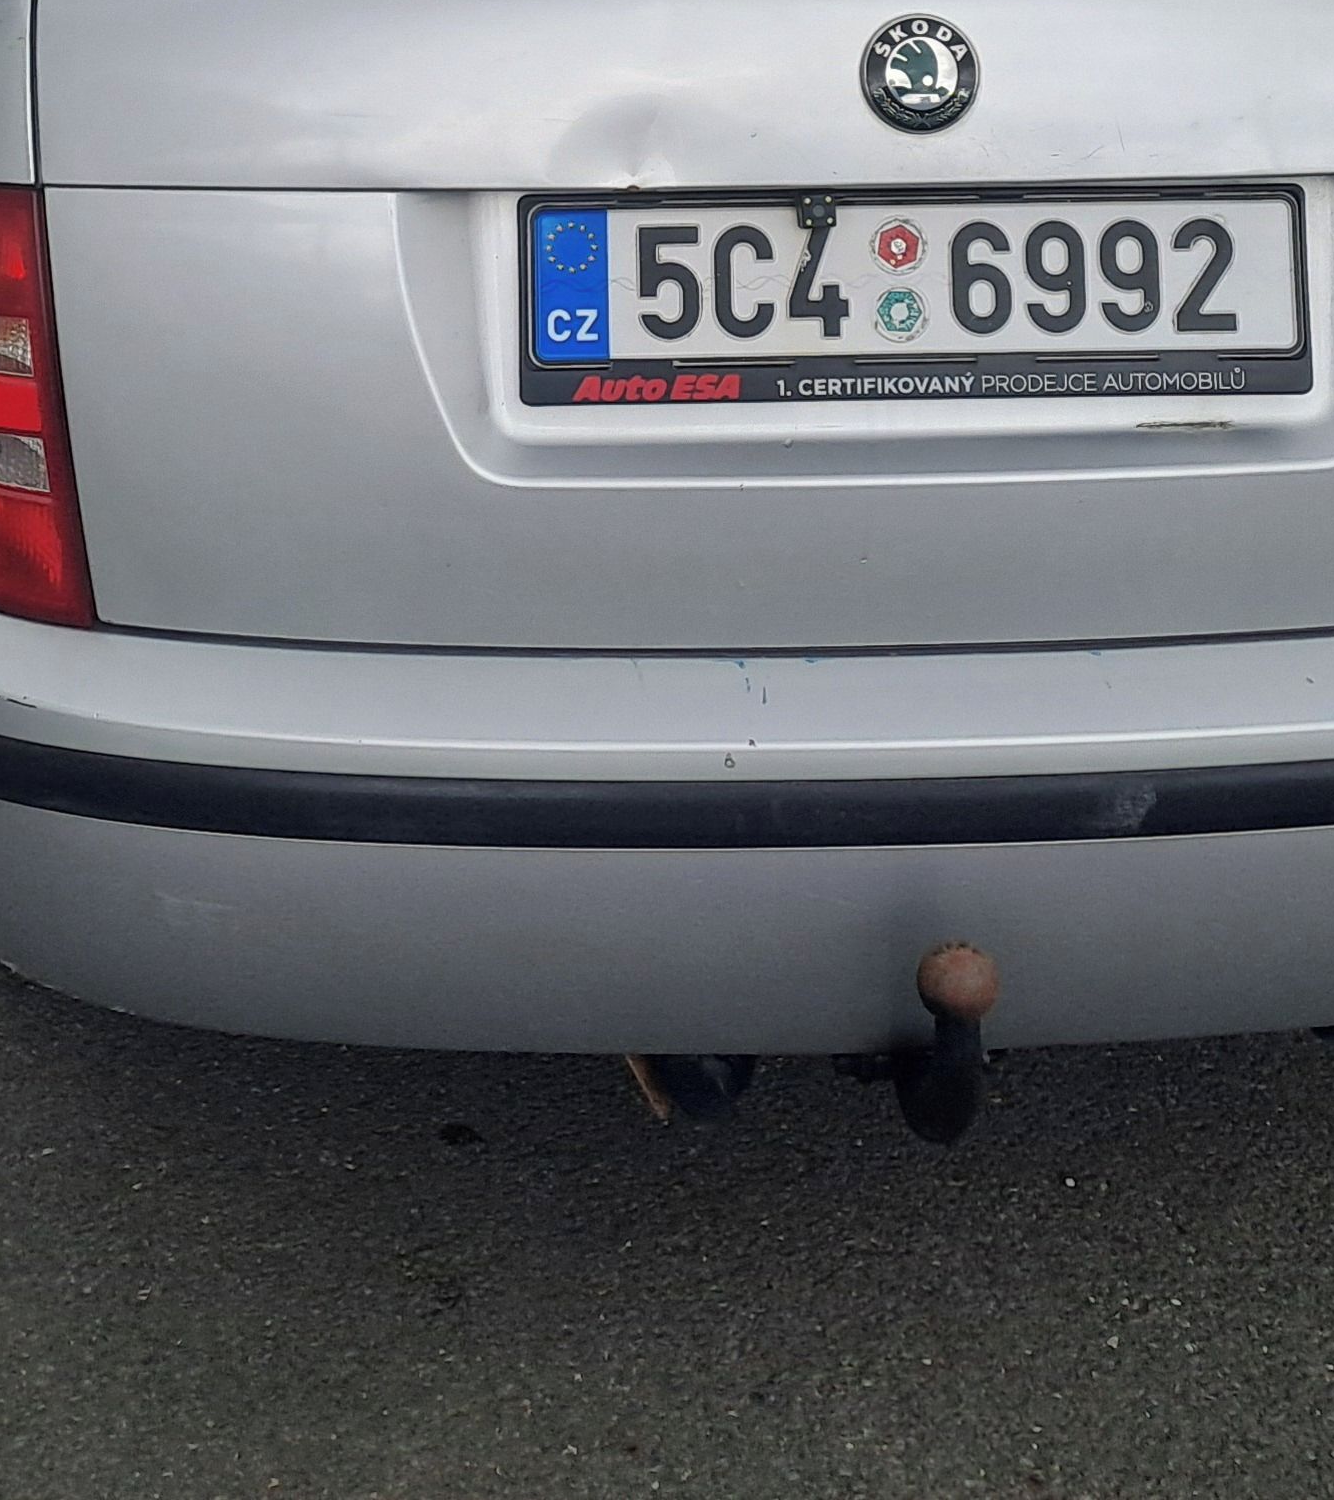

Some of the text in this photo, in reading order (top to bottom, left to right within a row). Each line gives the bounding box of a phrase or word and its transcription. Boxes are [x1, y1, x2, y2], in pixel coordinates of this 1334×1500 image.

[546, 218, 1240, 342] CZ 5C4 6992
[572, 366, 1247, 402] Auto ESA 1. CERTIFIKOVANÝ PRODEJCE AUTOMOBILŮ
